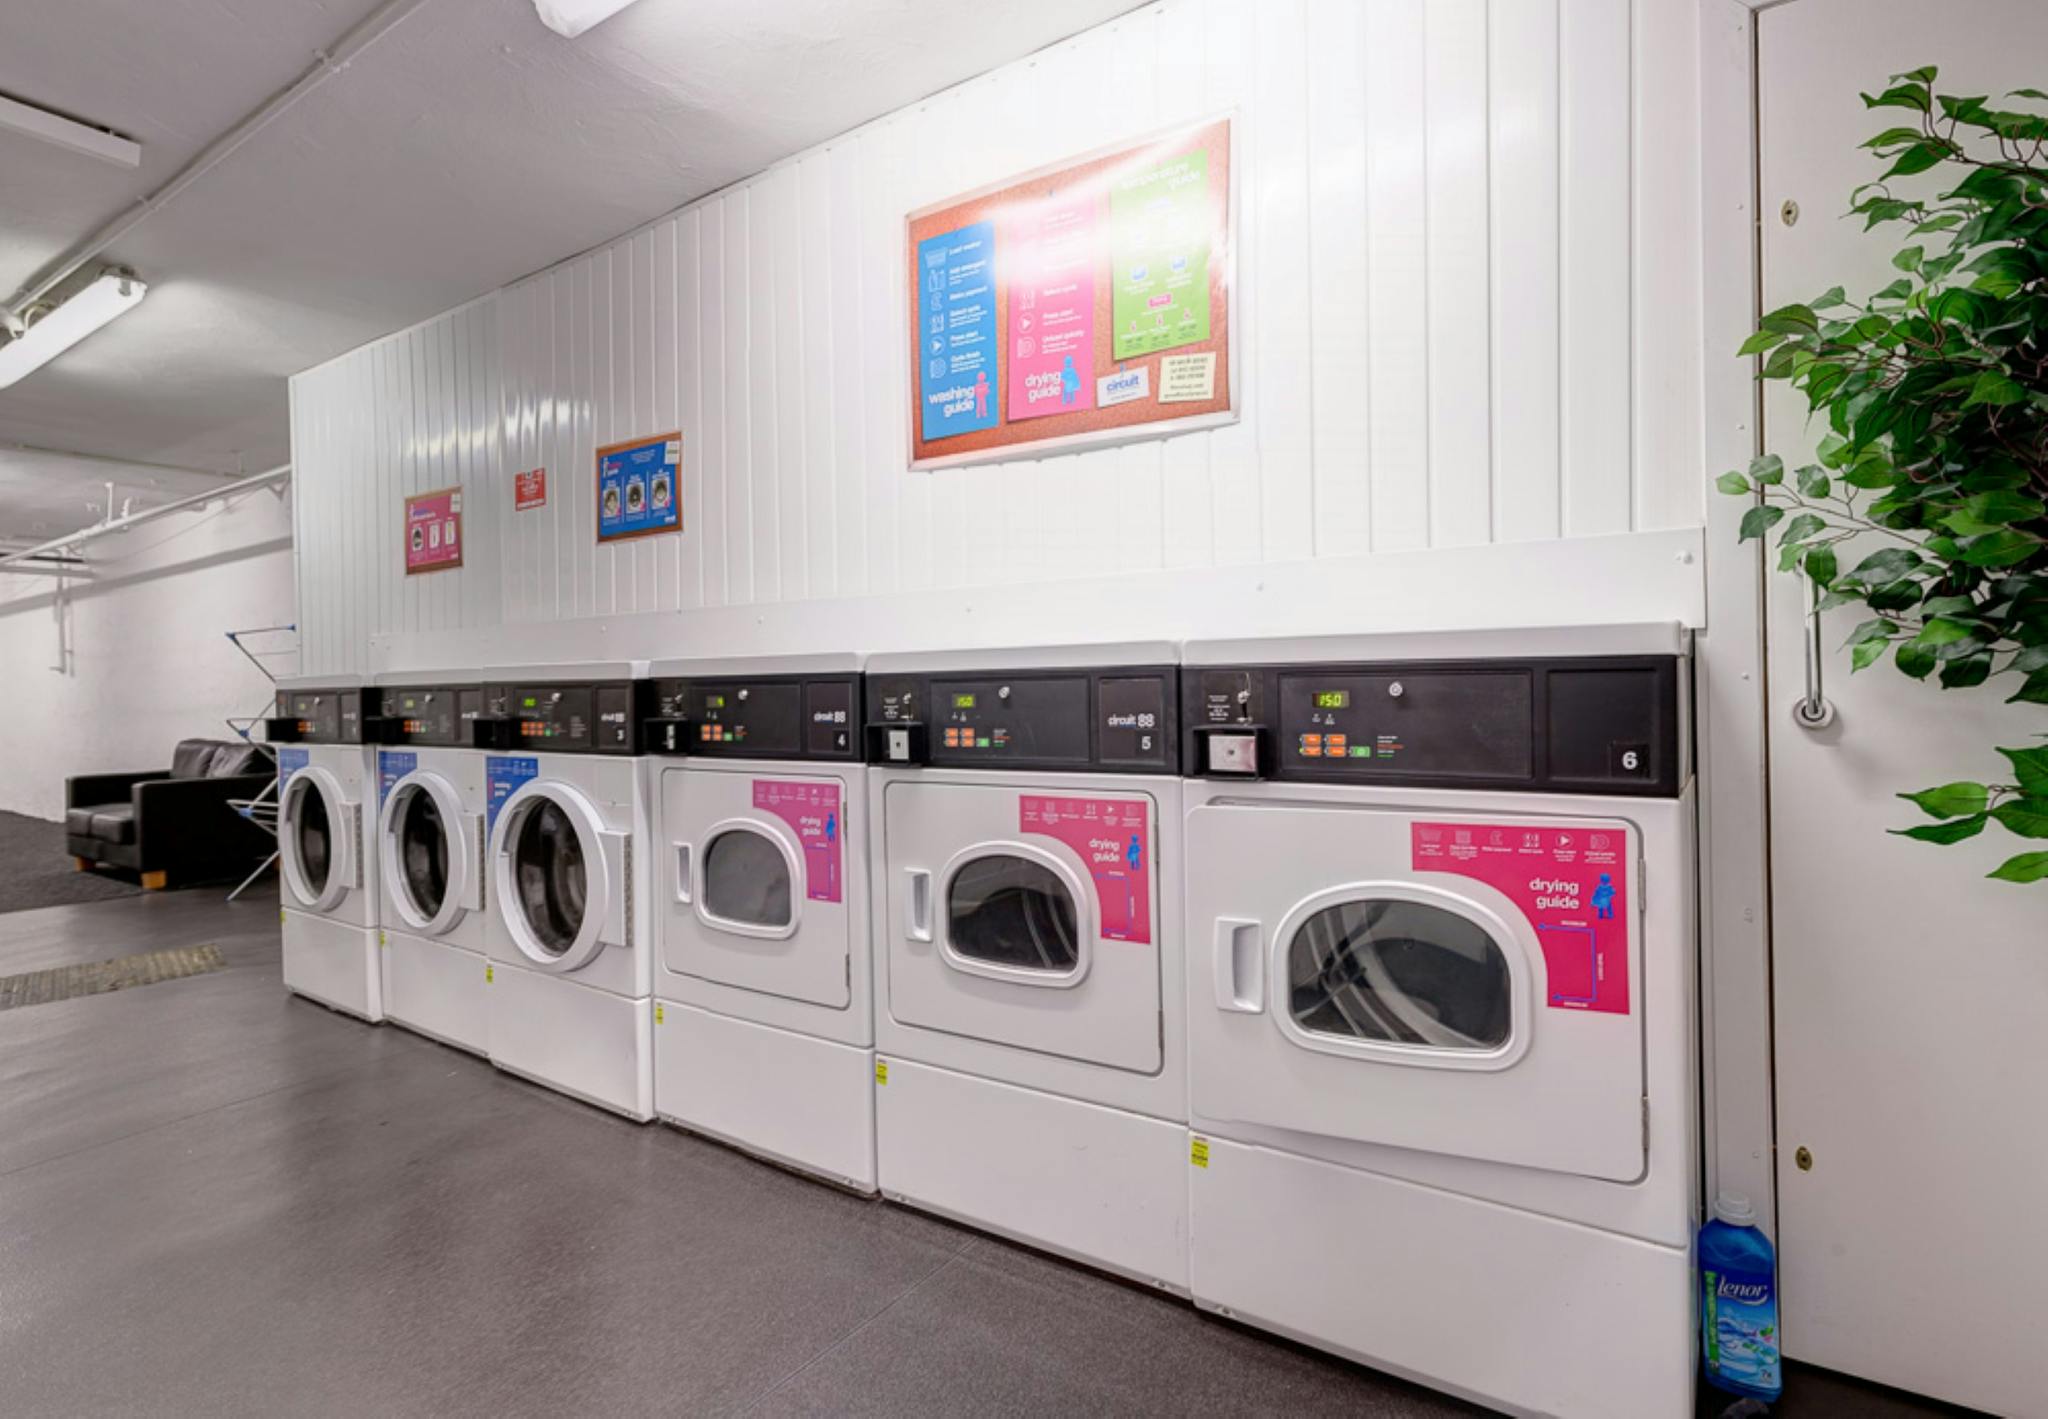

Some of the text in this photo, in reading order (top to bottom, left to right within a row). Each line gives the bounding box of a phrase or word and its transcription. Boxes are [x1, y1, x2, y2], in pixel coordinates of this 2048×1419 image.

[1024, 372, 1061, 388] drying
[1106, 375, 1139, 392] circuit
[928, 386, 977, 405] washing
[1028, 386, 1061, 404] guide
[943, 400, 975, 418] guide
[1107, 712, 1155, 728] circuit 88
[838, 734, 846, 747] 4
[1142, 735, 1152, 750] 5
[1622, 751, 1638, 770] 6
[1089, 837, 1120, 852] drying
[1093, 852, 1120, 864] guide
[1529, 877, 1580, 895] drying
[1536, 893, 1580, 909] guide
